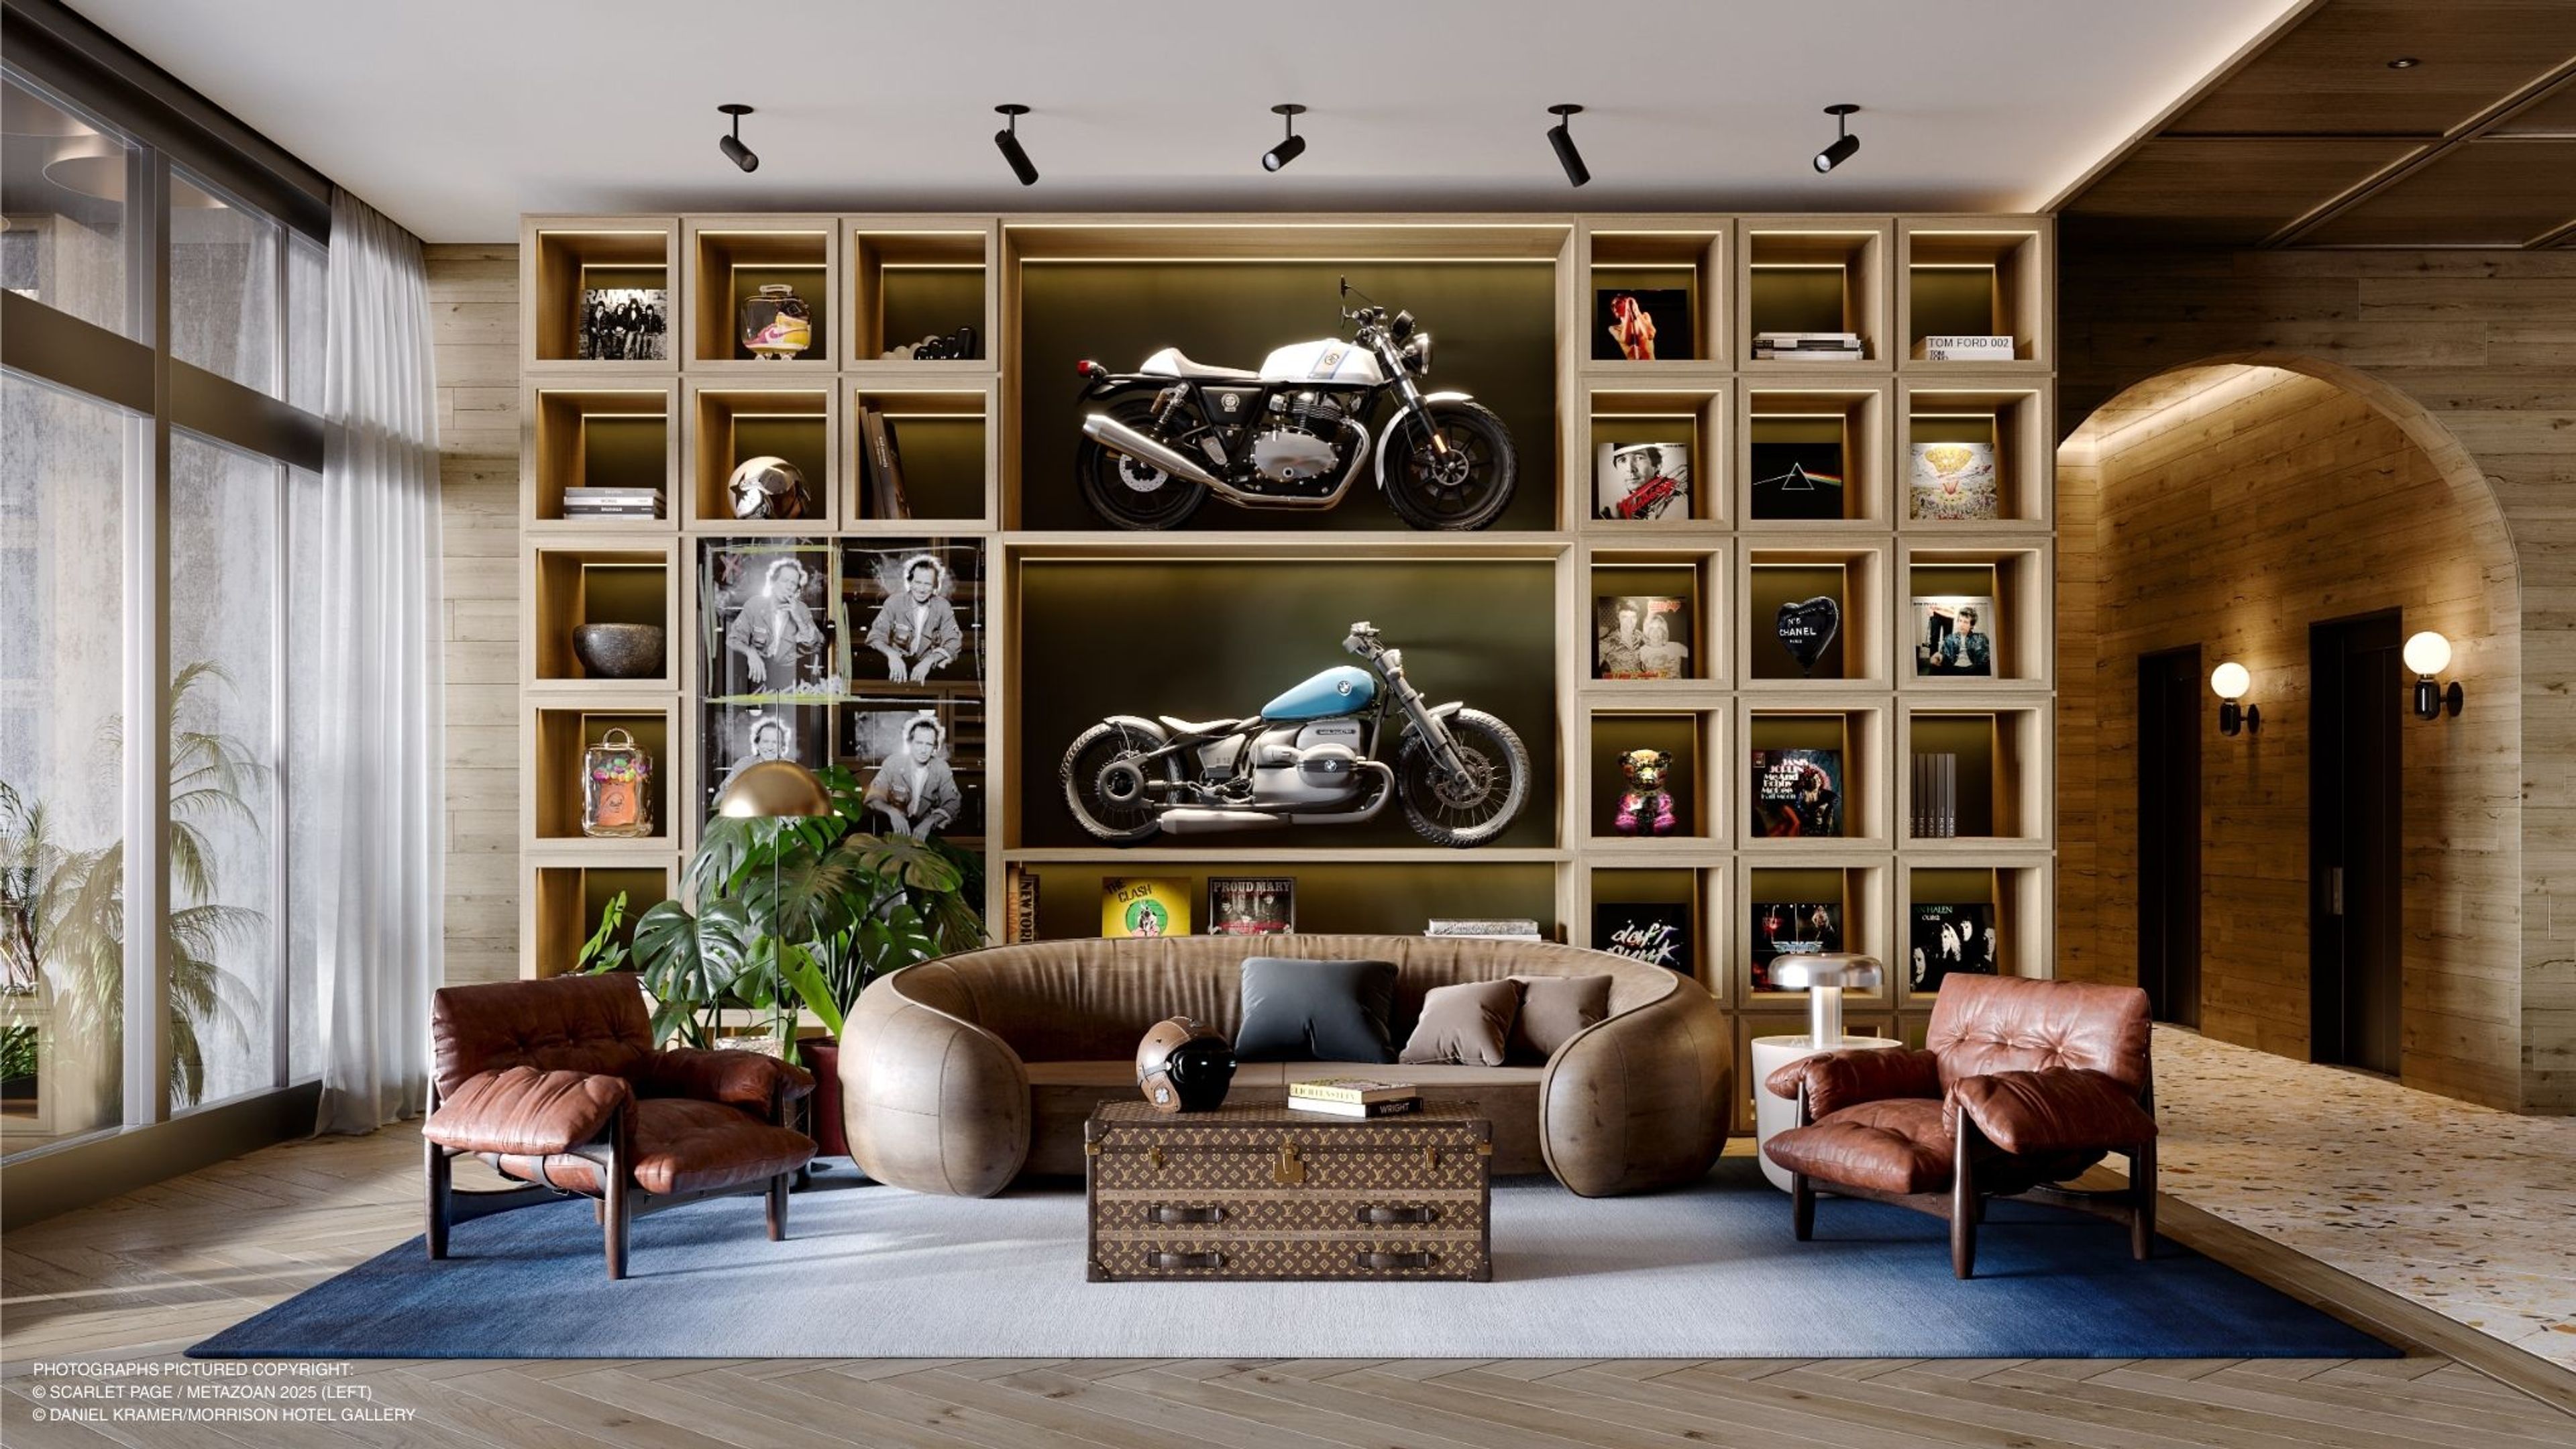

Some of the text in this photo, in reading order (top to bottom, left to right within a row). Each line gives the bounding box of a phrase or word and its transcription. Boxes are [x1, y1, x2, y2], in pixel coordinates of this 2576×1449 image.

[1928, 338, 2009, 347] TOM FORD 002
[1779, 627, 1817, 637] CHANEL
[1106, 877, 1127, 895] THE
[1213, 881, 1291, 892] PROUD MARY
[1020, 880, 1032, 910] NEW
[1118, 883, 1152, 903] CLASH
[1379, 1102, 1410, 1114] WRIGHT
